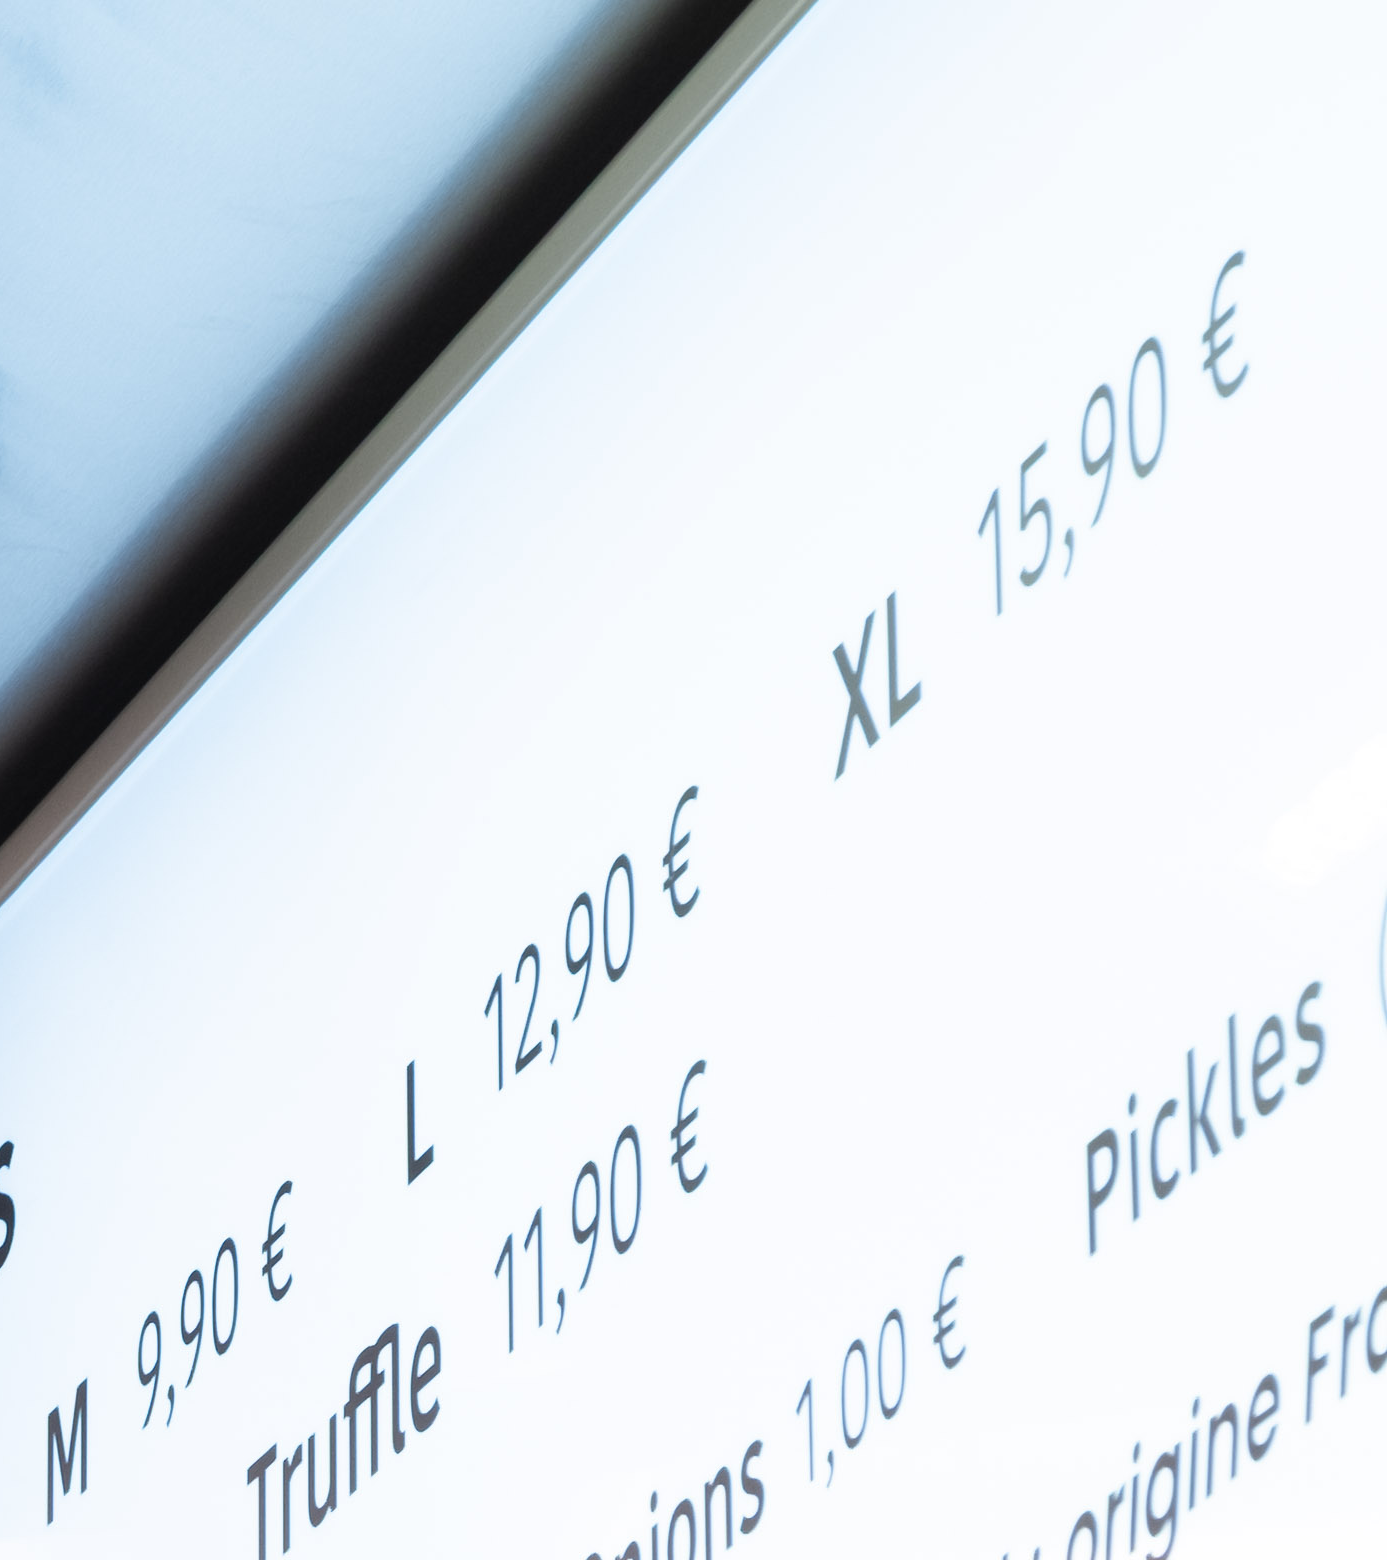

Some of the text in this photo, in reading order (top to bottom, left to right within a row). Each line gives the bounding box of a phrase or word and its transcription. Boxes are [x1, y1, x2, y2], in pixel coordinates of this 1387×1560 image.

[46, 1375, 89, 1528] M
[136, 1236, 240, 1431] 9,90
[260, 1179, 295, 1304] €
[405, 1058, 436, 1187] L
[483, 852, 636, 1093] 12,90
[661, 784, 702, 920] €
[831, 589, 924, 784] XL
[976, 334, 1169, 617] 15,90
[1200, 248, 1251, 401] €
[493, 1123, 644, 1355] 11,90
[668, 1058, 710, 1195] €
[794, 1306, 908, 1489] 1,00
[931, 1253, 968, 1372] €
[1084, 979, 1328, 1258] Pickles
